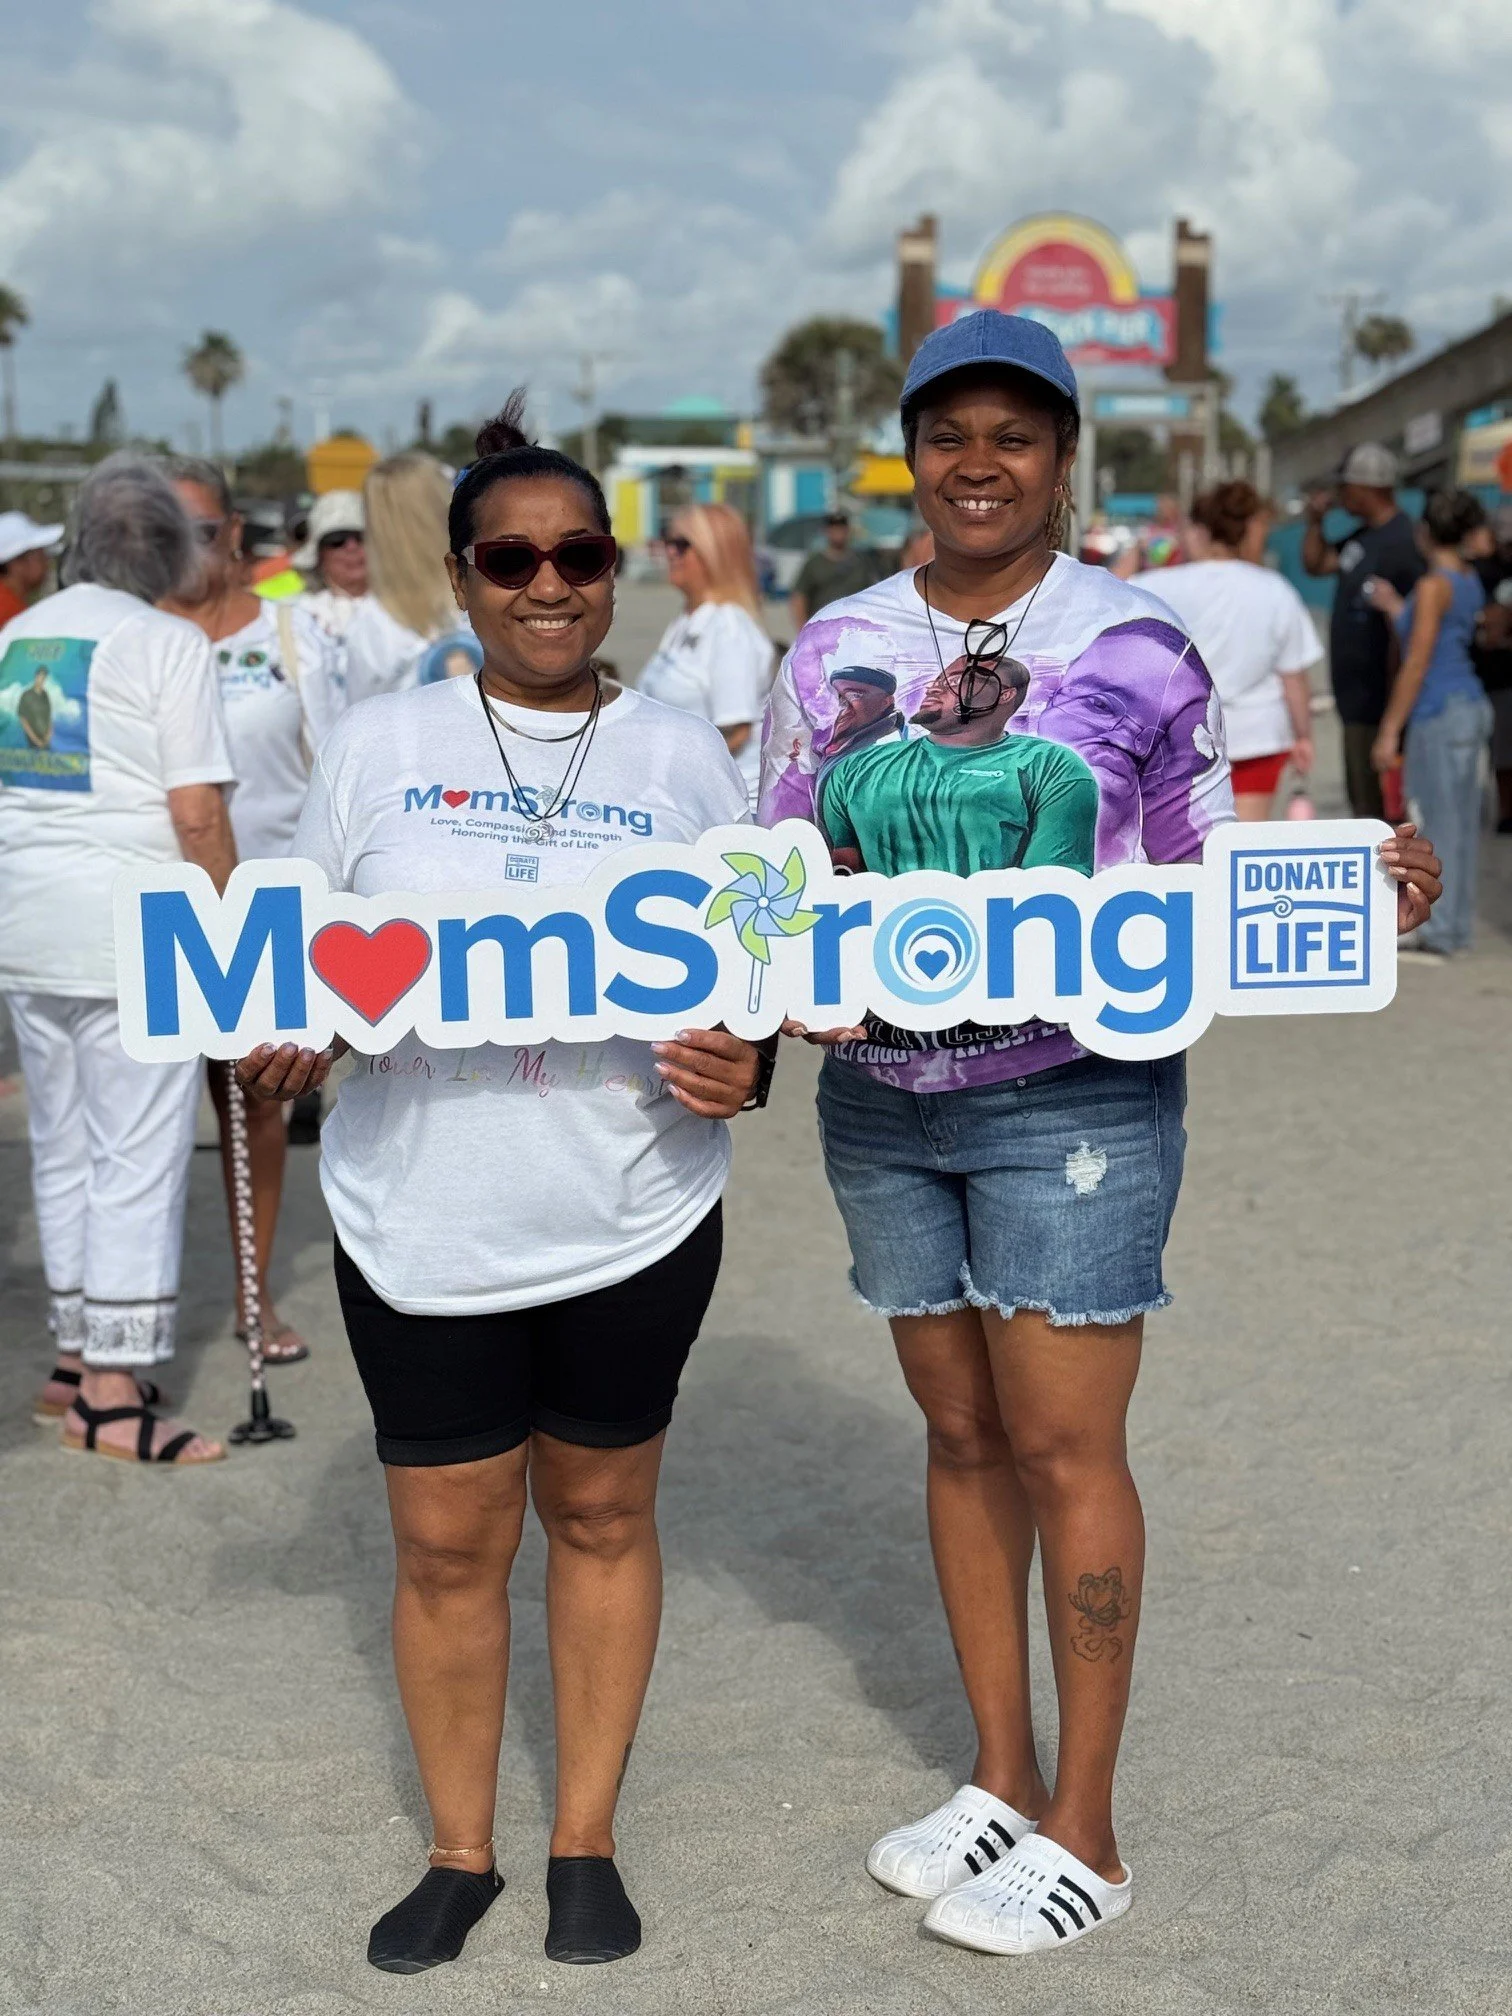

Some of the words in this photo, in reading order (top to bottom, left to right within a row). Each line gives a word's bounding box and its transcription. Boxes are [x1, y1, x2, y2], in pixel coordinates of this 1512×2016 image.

[430, 817, 462, 827] Love,
[465, 818, 536, 834] Compassi
[569, 829, 622, 842] Strength
[451, 828, 508, 844] Honoring
[561, 840, 574, 848] of
[576, 840, 600, 850] Life
[508, 866, 536, 880] LIFE
[509, 856, 537, 865] DONATE
[1244, 860, 1358, 892] DONATE
[1246, 920, 1357, 974] LIFE
[506, 1047, 562, 1097] My
